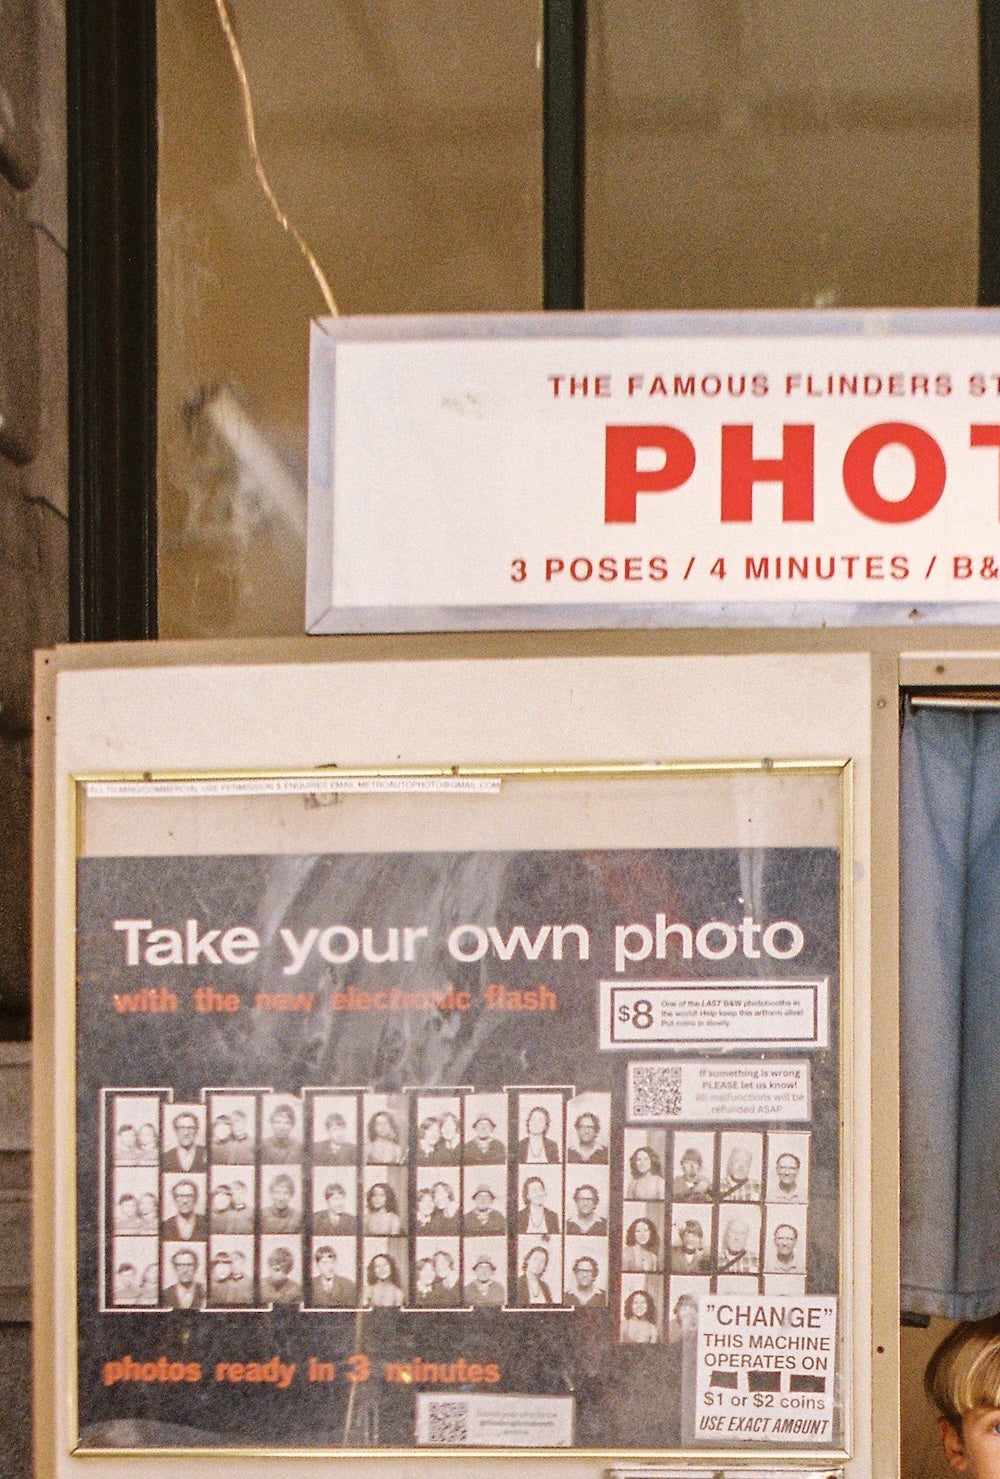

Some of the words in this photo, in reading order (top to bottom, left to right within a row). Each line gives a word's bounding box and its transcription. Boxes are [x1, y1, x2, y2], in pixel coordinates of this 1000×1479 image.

[548, 373, 612, 398] THE
[627, 373, 770, 398] FAMOUS
[785, 373, 953, 398] FLINDERS
[510, 557, 528, 582] 3
[544, 556, 669, 582] POSES
[709, 556, 728, 581] 4
[744, 555, 910, 581] MINUTES
[113, 918, 260, 966] Take
[280, 923, 429, 976] your
[447, 923, 590, 963] own
[614, 913, 805, 973] photo
[113, 987, 178, 1013] with
[193, 986, 241, 1013] the
[253, 991, 316, 1012] new
[484, 984, 557, 1012] flash
[701, 999, 721, 1007] LAST
[723, 999, 742, 1007] B&W
[617, 999, 654, 1030] $8
[718, 1010, 738, 1019] keep
[739, 1009, 753, 1018] this
[708, 1068, 759, 1080] something
[761, 1069, 769, 1078] is
[771, 1070, 801, 1079] wrong
[702, 1081, 739, 1090] PLEASE
[740, 1081, 754, 1090] let
[756, 1082, 767, 1090] us
[769, 1081, 798, 1090] know!
[709, 1092, 771, 1102] malfunctions
[773, 1093, 790, 1102] will
[792, 1093, 805, 1102] be
[711, 1105, 756, 1114] refunded
[703, 1333, 743, 1348] THIS
[749, 1335, 831, 1352] MACHINE
[102, 1355, 202, 1388] photos
[213, 1355, 296, 1389] ready
[307, 1356, 335, 1383] in
[346, 1353, 371, 1383] 3
[386, 1356, 501, 1384] minutes
[704, 1353, 796, 1370] OPERATES
[801, 1356, 828, 1371] ON
[703, 1391, 723, 1406] $1
[731, 1395, 748, 1407] or
[752, 1393, 774, 1408] $2
[780, 1395, 826, 1410] coins
[699, 1415, 726, 1431] USE
[727, 1416, 771, 1432] EXACT
[771, 1418, 830, 1435] AMOUNT
